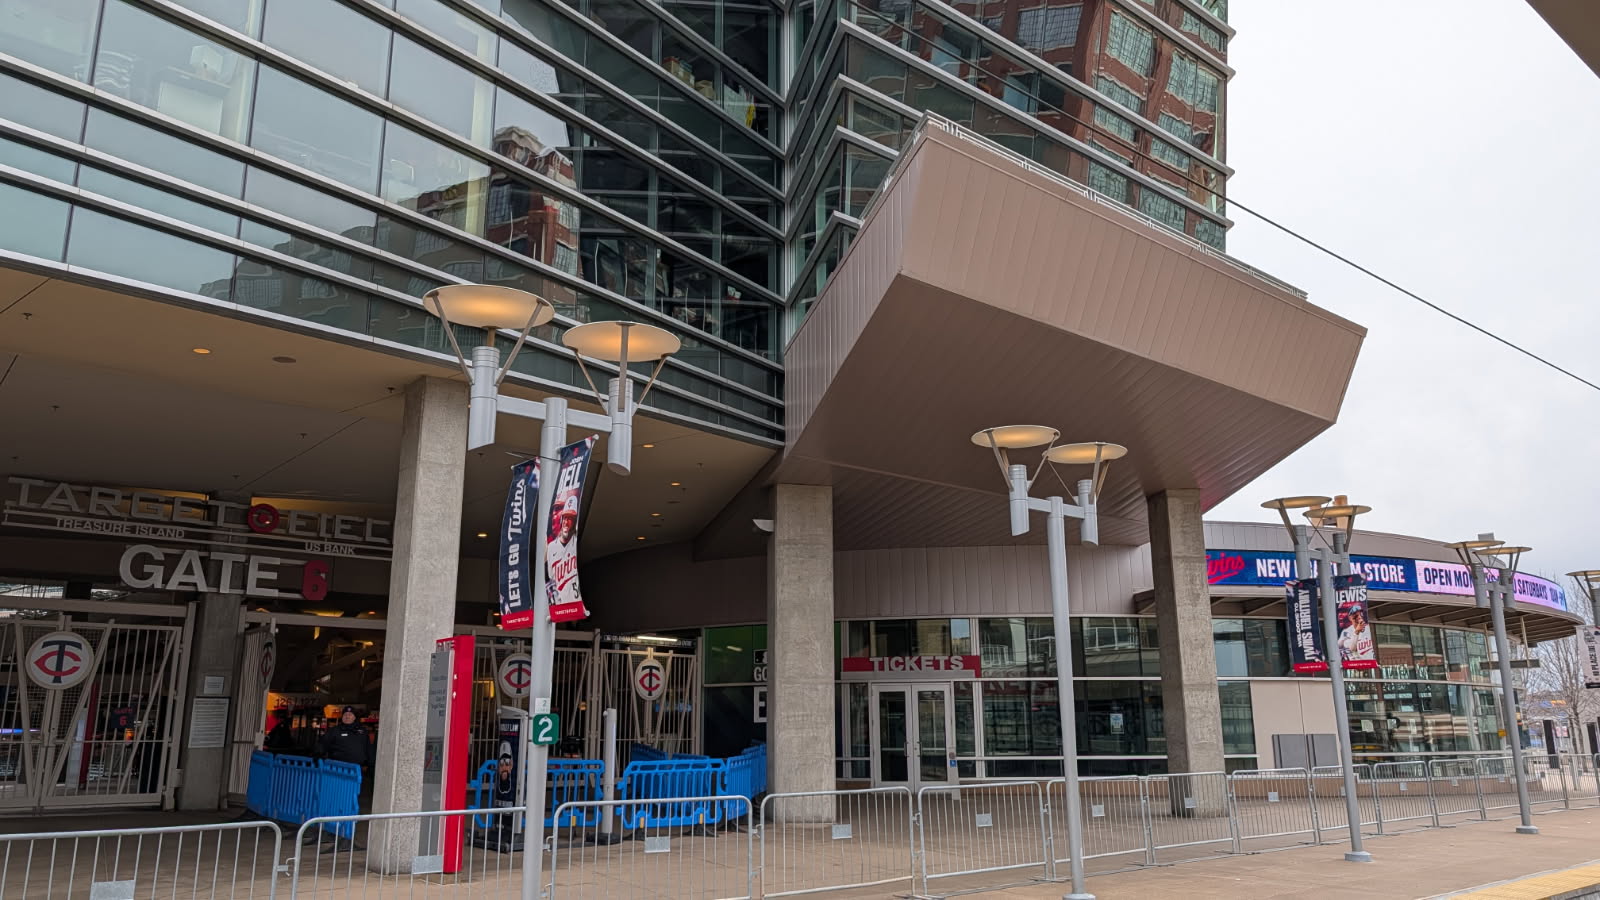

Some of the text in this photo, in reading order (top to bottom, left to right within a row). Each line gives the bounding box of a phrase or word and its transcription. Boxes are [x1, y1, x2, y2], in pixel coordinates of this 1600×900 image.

[557, 463, 582, 494] BELL
[7, 476, 247, 528] TARGET
[56, 517, 185, 539] TREASURE ISLAND
[507, 478, 527, 608] LET'S GO Twins
[304, 542, 356, 556] US BANK
[119, 544, 328, 602] GATE 6
[1206, 552, 1246, 584] wins
[1256, 558, 1291, 579] NEW
[1365, 562, 1406, 583] STORE
[1424, 567, 1452, 587] OPEN
[1517, 578, 1548, 601] SATURDAYS
[1298, 589, 1312, 630] TERRITORY
[1335, 588, 1367, 604] LEWIS
[869, 656, 964, 672] TICKETS
[538, 717, 553, 742] 2
